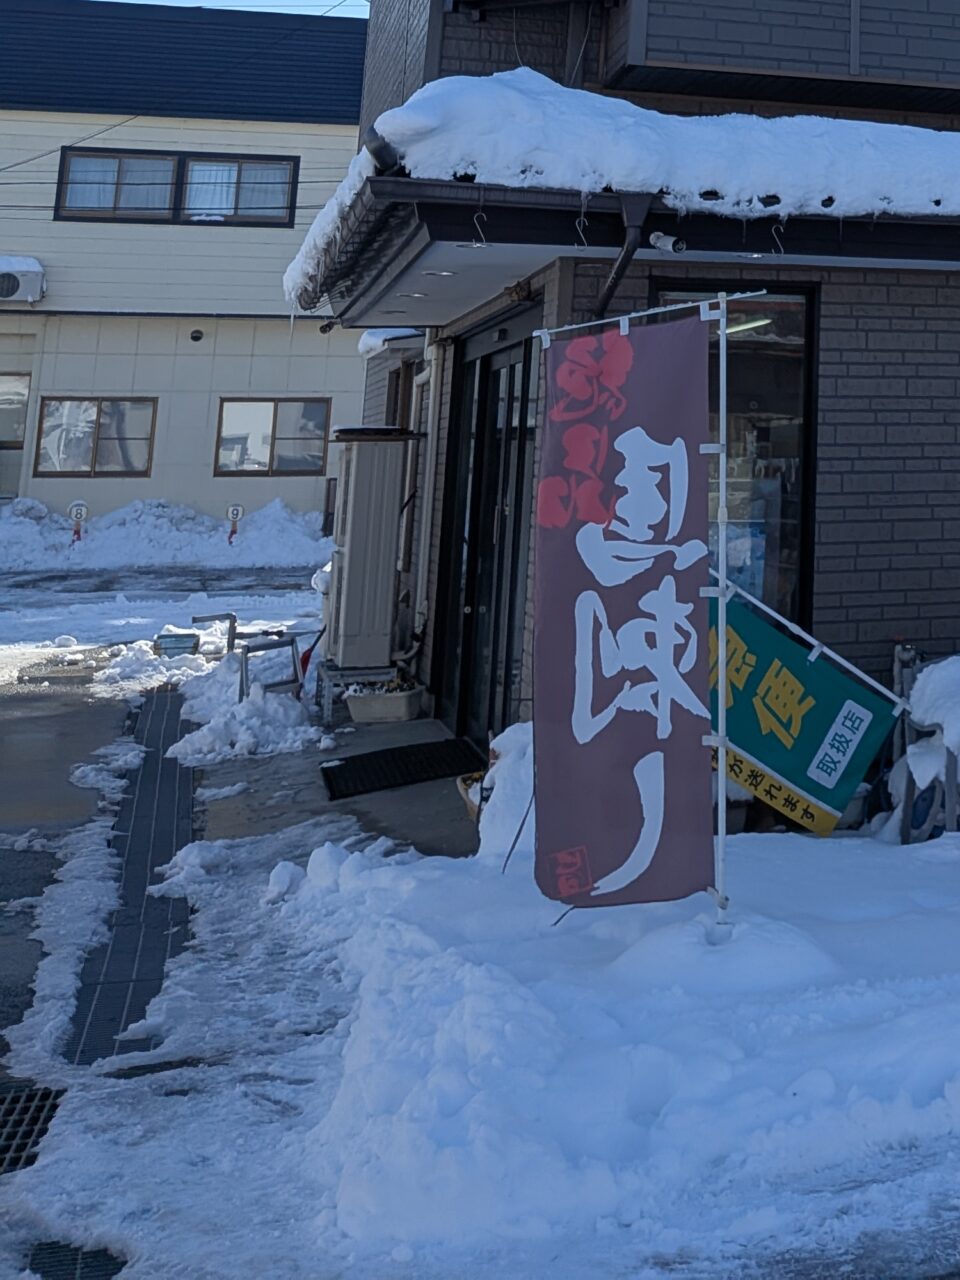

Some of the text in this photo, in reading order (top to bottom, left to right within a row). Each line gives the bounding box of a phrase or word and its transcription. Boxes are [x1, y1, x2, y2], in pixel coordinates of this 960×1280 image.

[230, 508, 239, 520] 9
[816, 710, 865, 777] 取扱店
